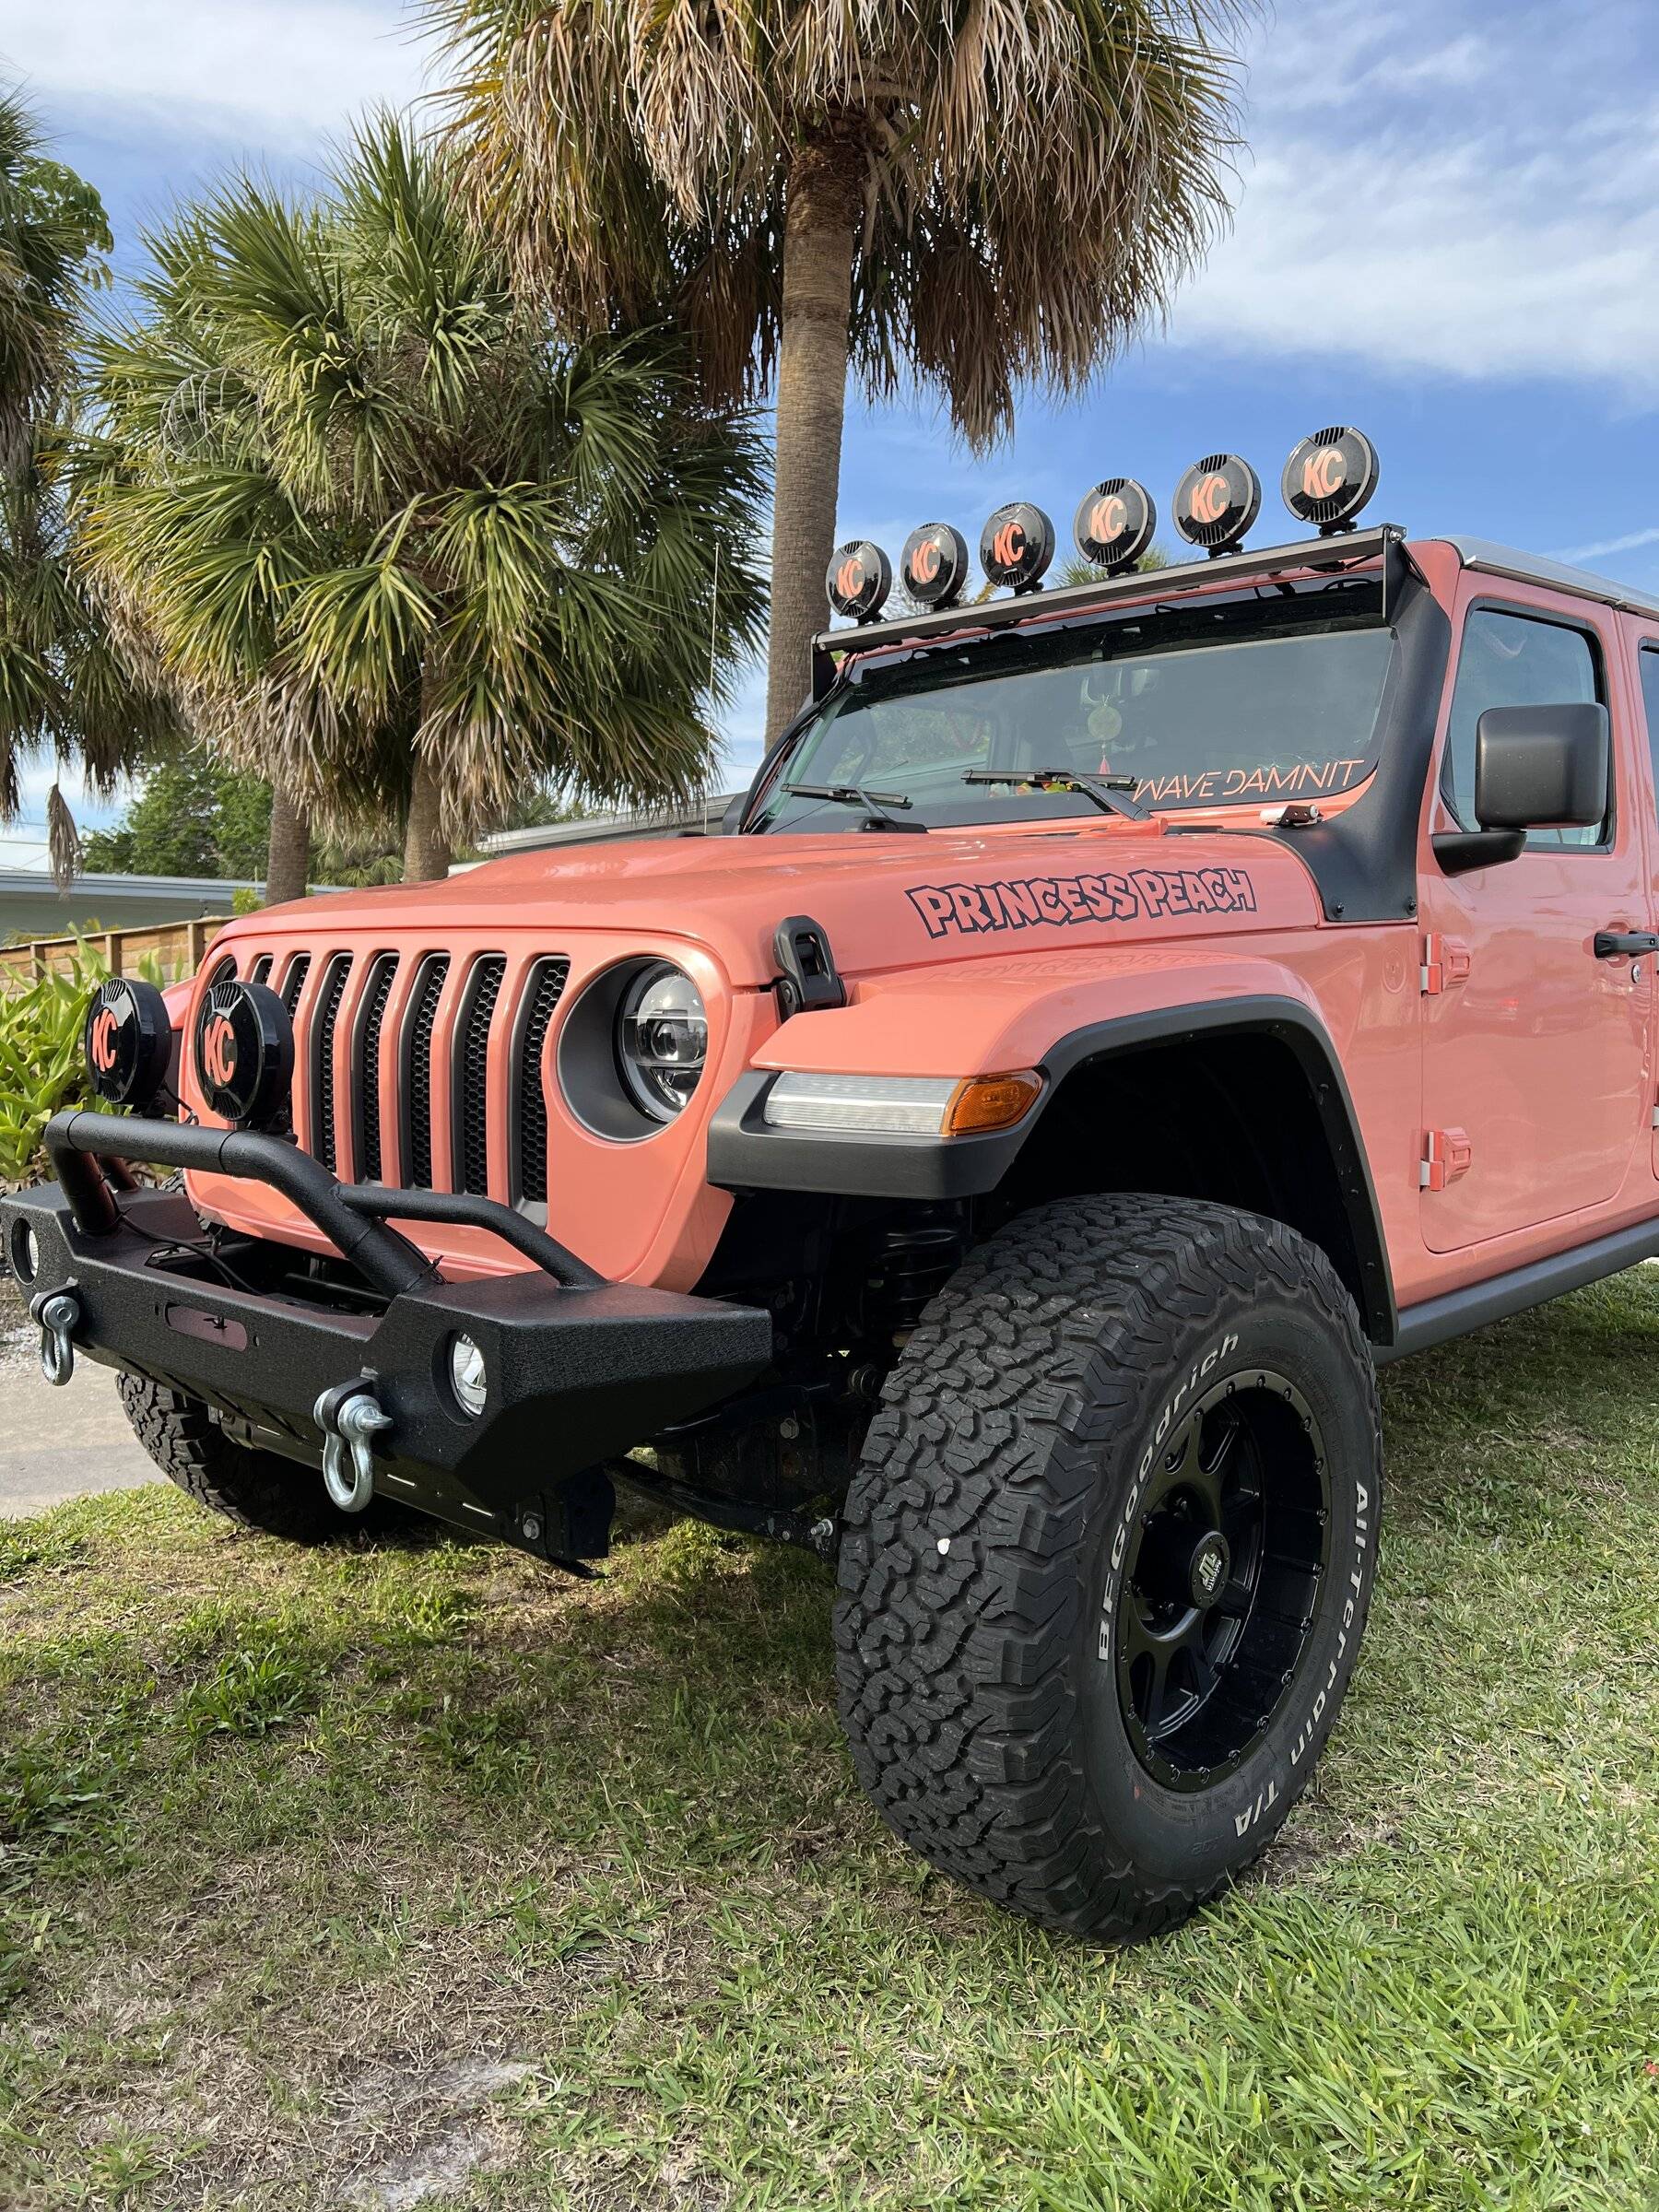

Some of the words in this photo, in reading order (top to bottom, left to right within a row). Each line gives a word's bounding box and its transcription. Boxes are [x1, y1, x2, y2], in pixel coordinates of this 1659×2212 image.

[1191, 473, 1227, 523] KC
[1302, 448, 1343, 499] KC
[993, 522, 1024, 567] KC
[1090, 497, 1124, 541] KC
[837, 559, 863, 600] KC
[911, 540, 938, 582] KC
[1132, 771, 1222, 803] WAVE
[1222, 759, 1365, 796] DAMNIT
[905, 872, 1138, 939] PRINCESS
[1129, 867, 1258, 918] PEACH
[92, 1008, 118, 1072] KC
[204, 1016, 235, 1087] KC
[1098, 1333, 1240, 1661] BFGoodrich
[1290, 1481, 1369, 1767] All-Terrain
[1234, 1780, 1279, 1838] T/A
